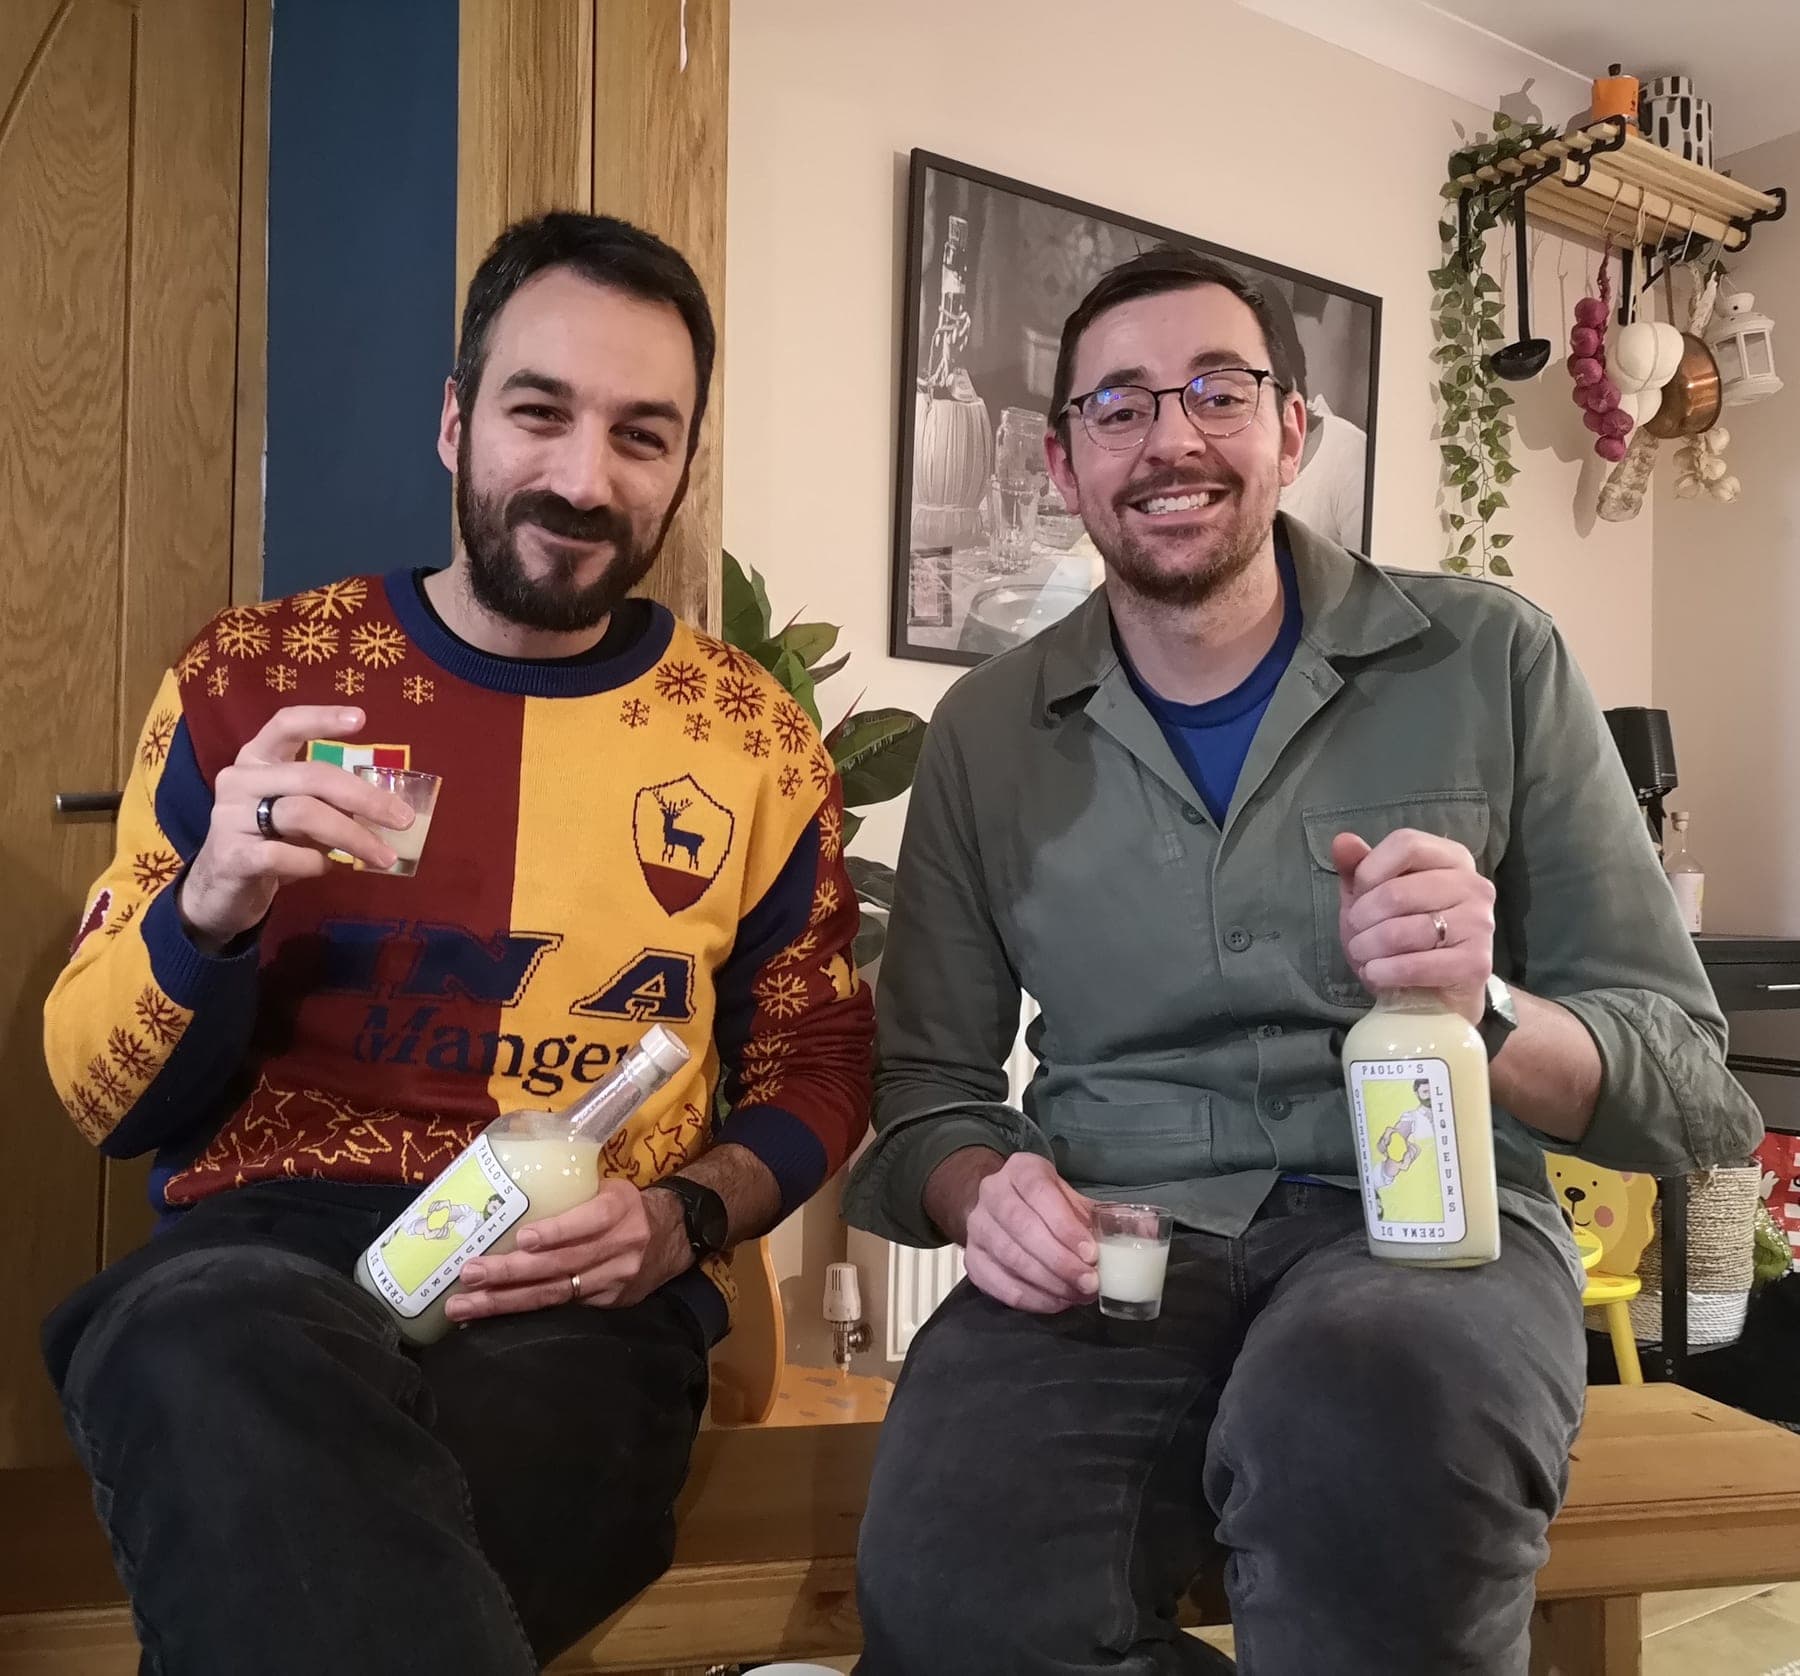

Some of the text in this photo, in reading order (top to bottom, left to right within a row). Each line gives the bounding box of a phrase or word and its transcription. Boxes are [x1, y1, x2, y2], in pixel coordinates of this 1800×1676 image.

[569, 947, 697, 1023] A
[1361, 1063, 1425, 1076] PAOLO'S
[477, 1144, 513, 1196] PAOLO'S
[1435, 1086, 1456, 1213] LIQUEURS
[420, 1212, 507, 1298] LIQUEURS
[1380, 1226, 1445, 1238] CREMA DI
